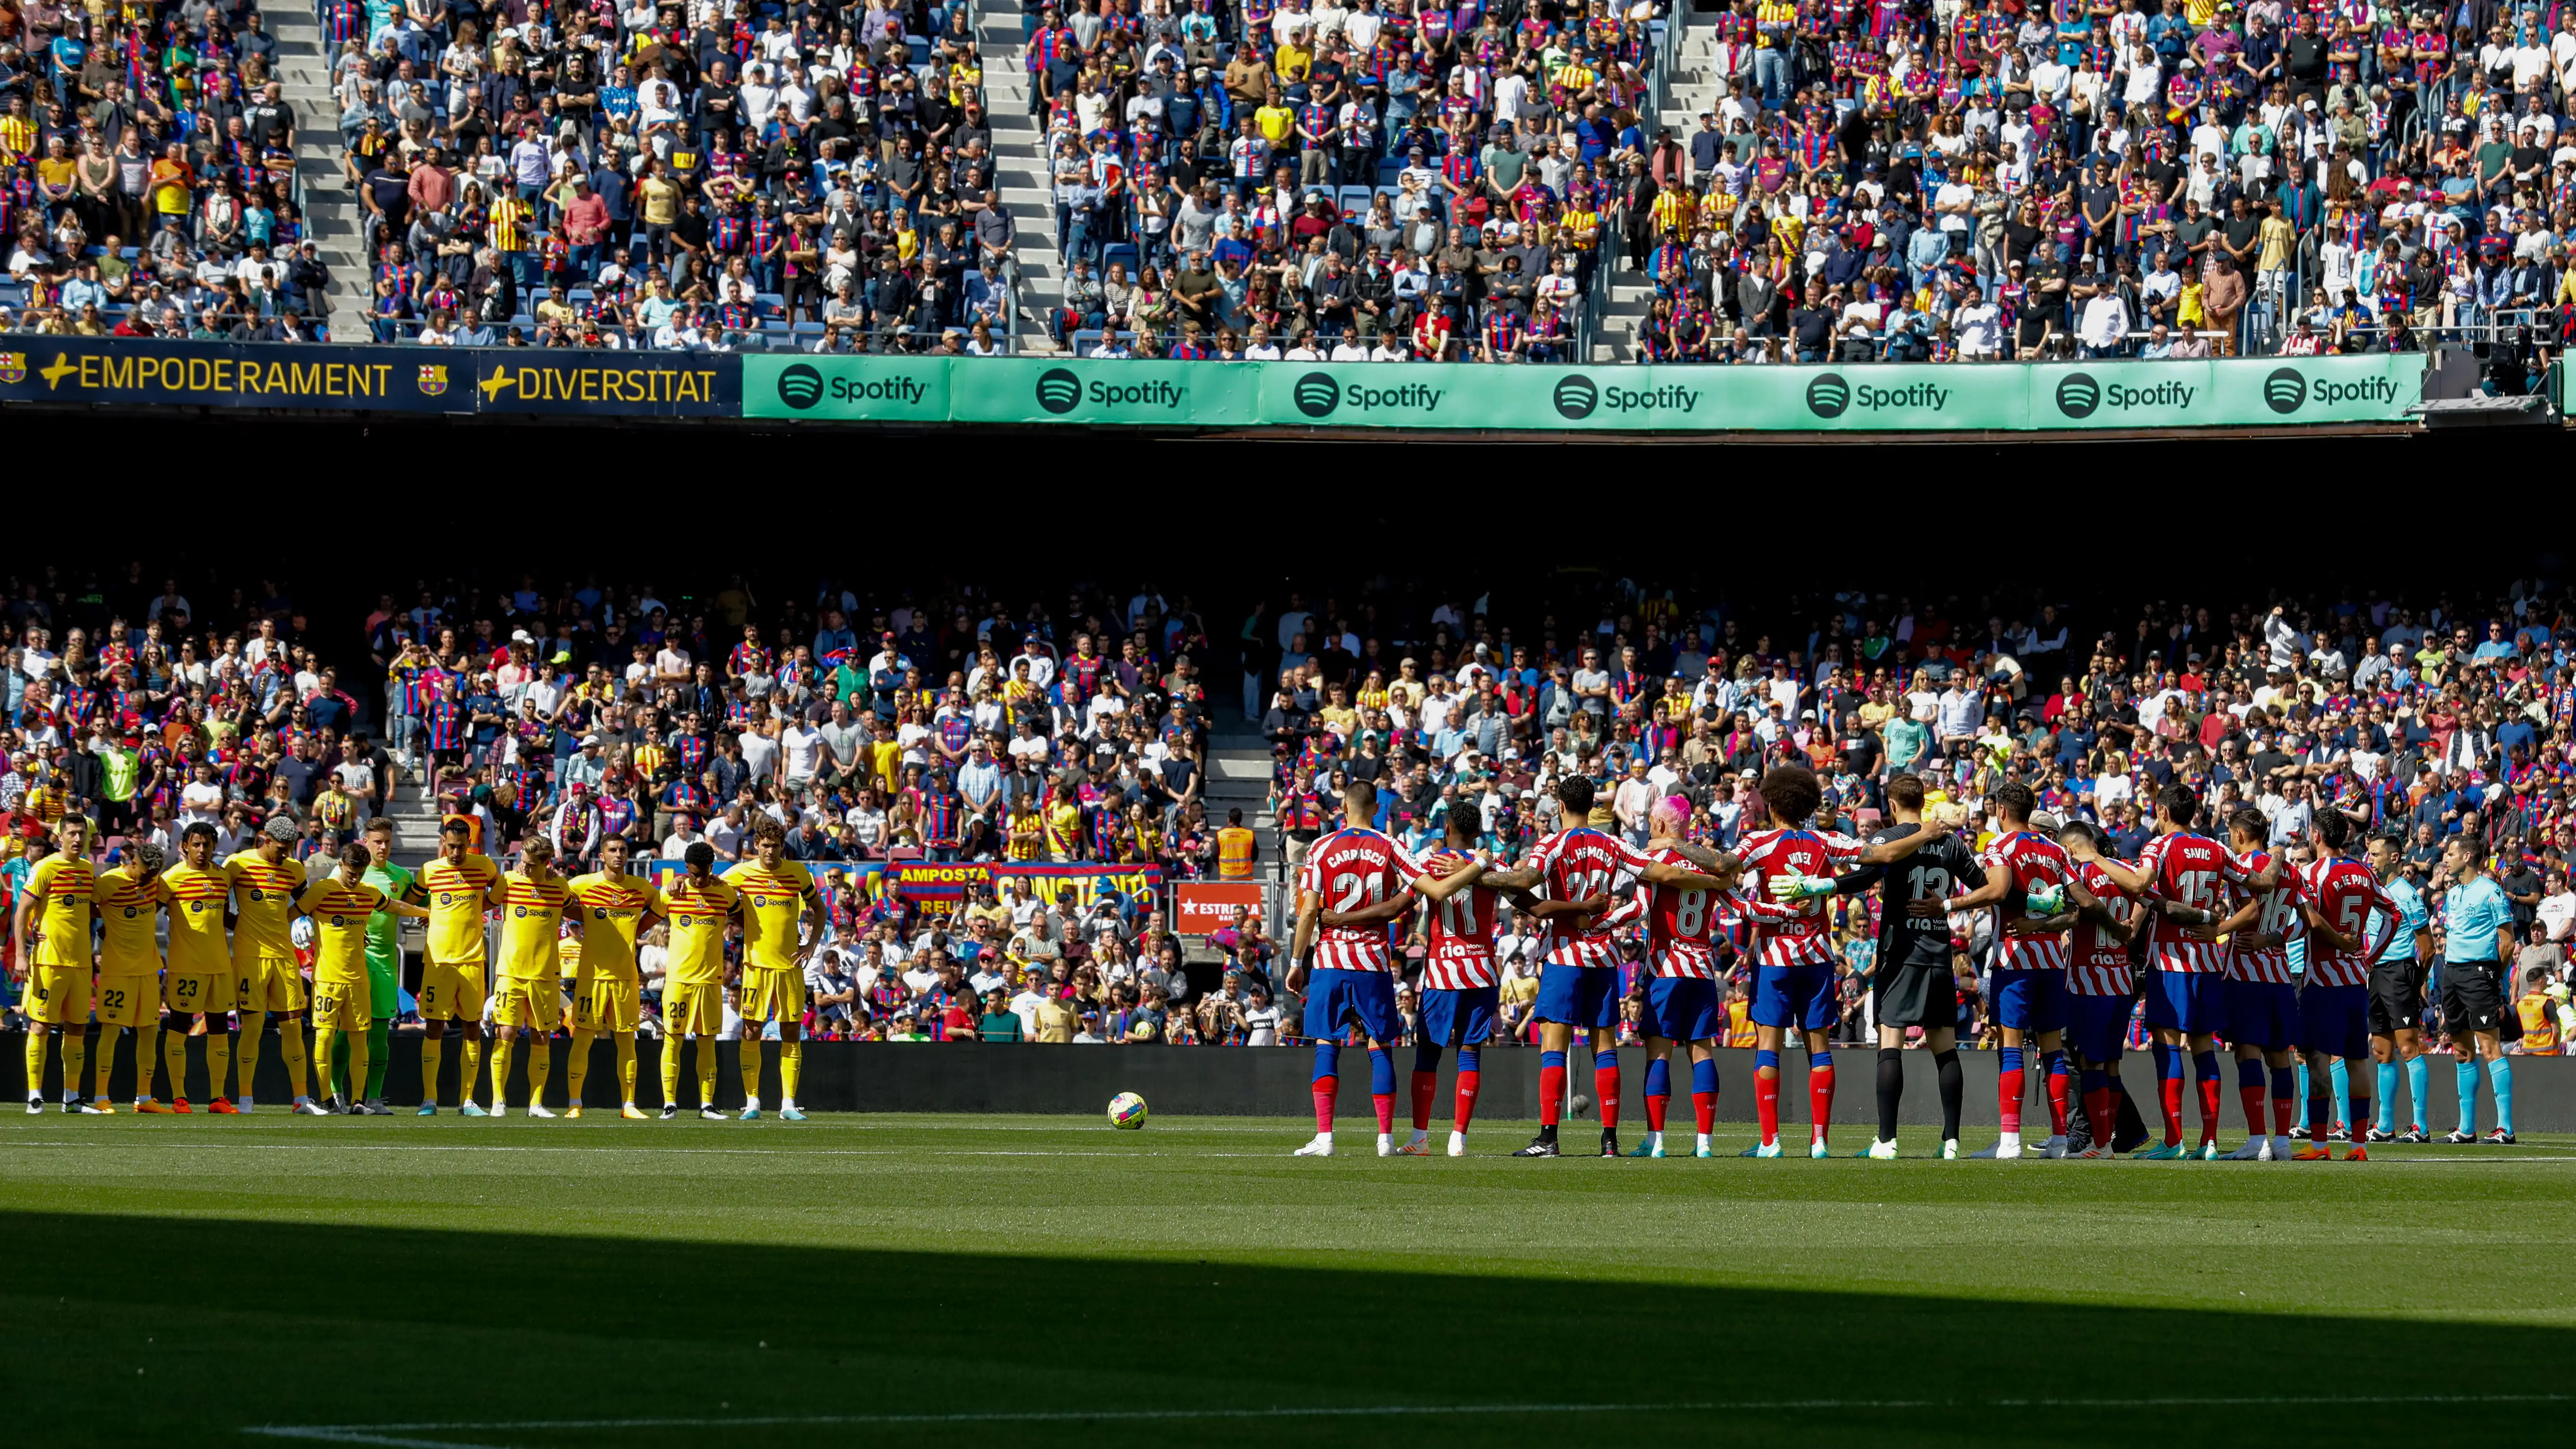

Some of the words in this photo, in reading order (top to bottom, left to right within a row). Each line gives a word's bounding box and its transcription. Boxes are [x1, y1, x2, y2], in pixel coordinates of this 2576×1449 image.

[830, 377, 926, 405] Spotify
[1089, 380, 1183, 408] Spotify
[1346, 383, 1442, 412] Spotify
[1603, 384, 1699, 413] Spotify
[1857, 382, 1948, 411] Spotify
[2107, 380, 2194, 410] Spotify
[2313, 376, 2398, 406] Spotify
[2184, 847, 2212, 861] SAVIĆ
[900, 868, 990, 882] AMPOSTA
[1332, 872, 1384, 913] 21
[2176, 870, 2217, 906] 15
[454, 893, 479, 901] Spotify
[768, 899, 792, 908] Spotify
[529, 910, 553, 919] Spotify
[1440, 889, 1477, 937] 11
[1677, 889, 1706, 937] 8
[2255, 888, 2292, 935] 16
[2340, 895, 2362, 938] 5
[346, 918, 366, 927] Spotify
[694, 918, 718, 927] Spotify
[1779, 920, 1805, 936] ria
[1906, 917, 1931, 931] ria
[1332, 925, 1361, 940] ria
[1440, 941, 1466, 958] ria
[2090, 951, 2114, 965] ria
[177, 979, 198, 997] 23
[239, 978, 250, 995] 4
[426, 986, 435, 1003] 5
[40, 988, 49, 1005] 9
[104, 989, 125, 1008] 22
[316, 995, 334, 1012] 30
[495, 990, 508, 1008] 21
[742, 987, 757, 1004] 17
[579, 996, 593, 1013] 11
[670, 1002, 687, 1019] 28
